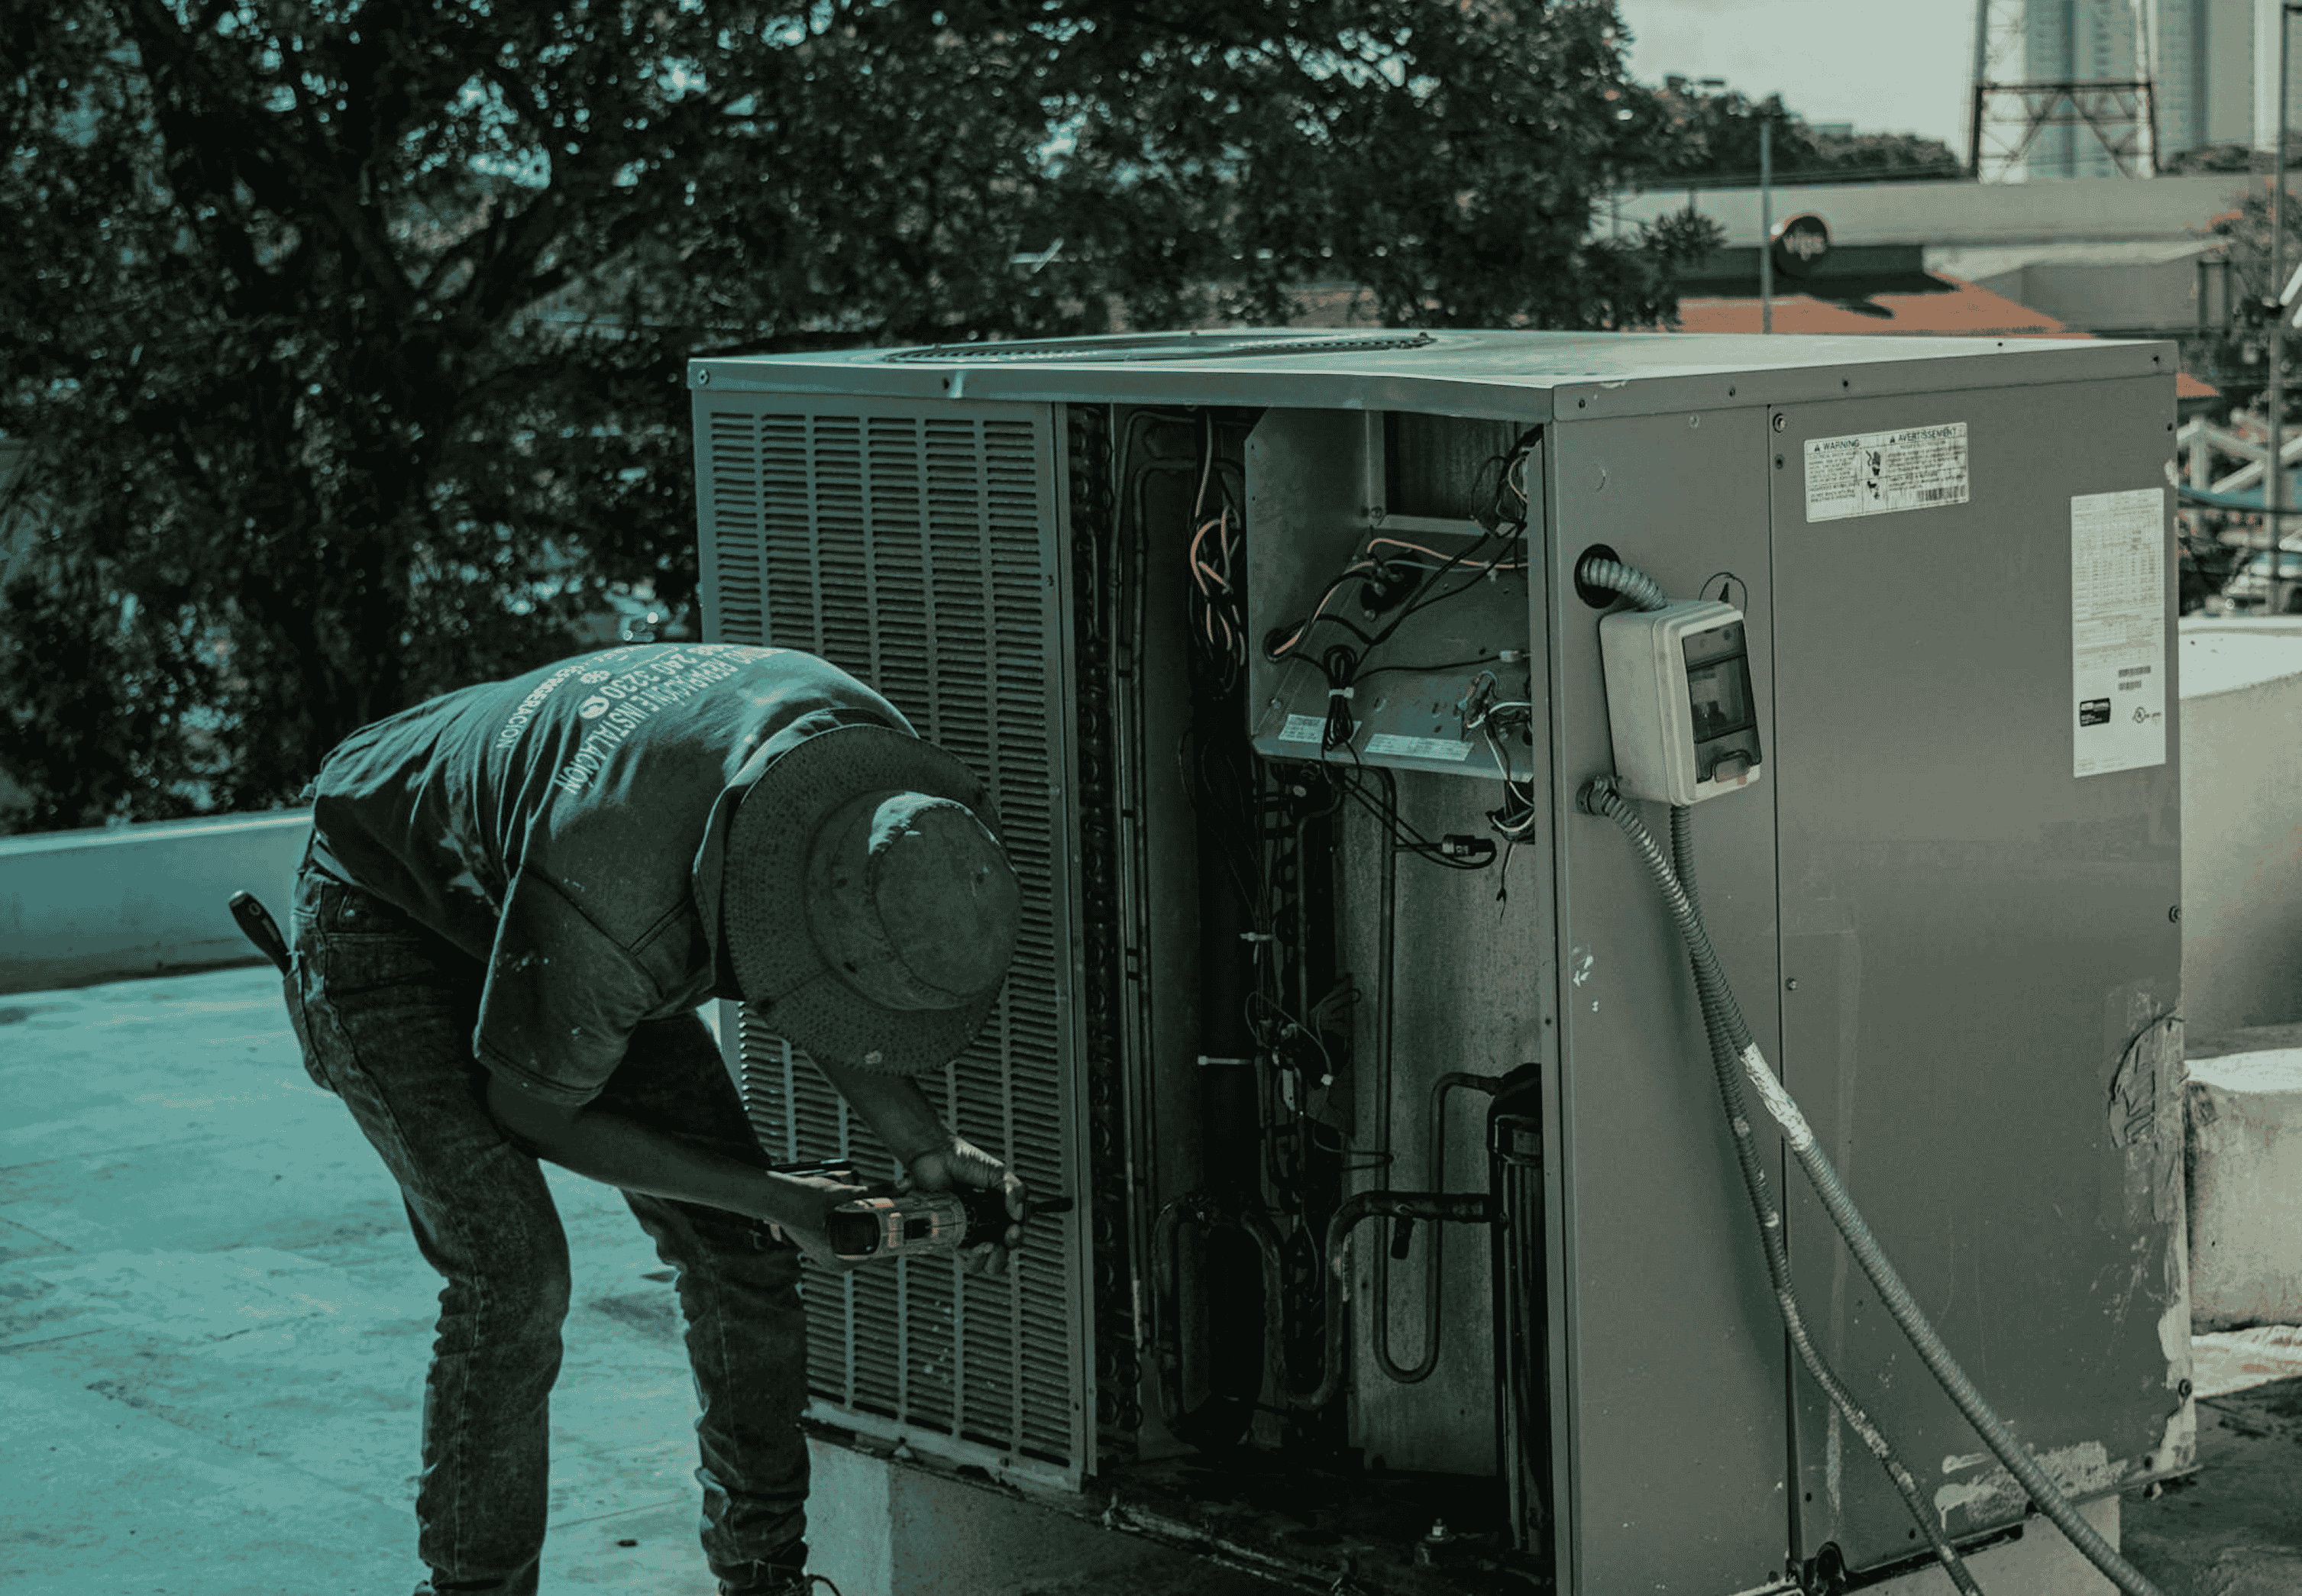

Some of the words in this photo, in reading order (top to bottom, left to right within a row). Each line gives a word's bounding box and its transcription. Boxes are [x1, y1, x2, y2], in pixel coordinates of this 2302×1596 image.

[1898, 426, 1957, 441] AVERTISSEMENT
[1823, 439, 1860, 451] WARNING
[600, 670, 660, 699] 3230
[553, 701, 650, 796] INSTALACIÓN
